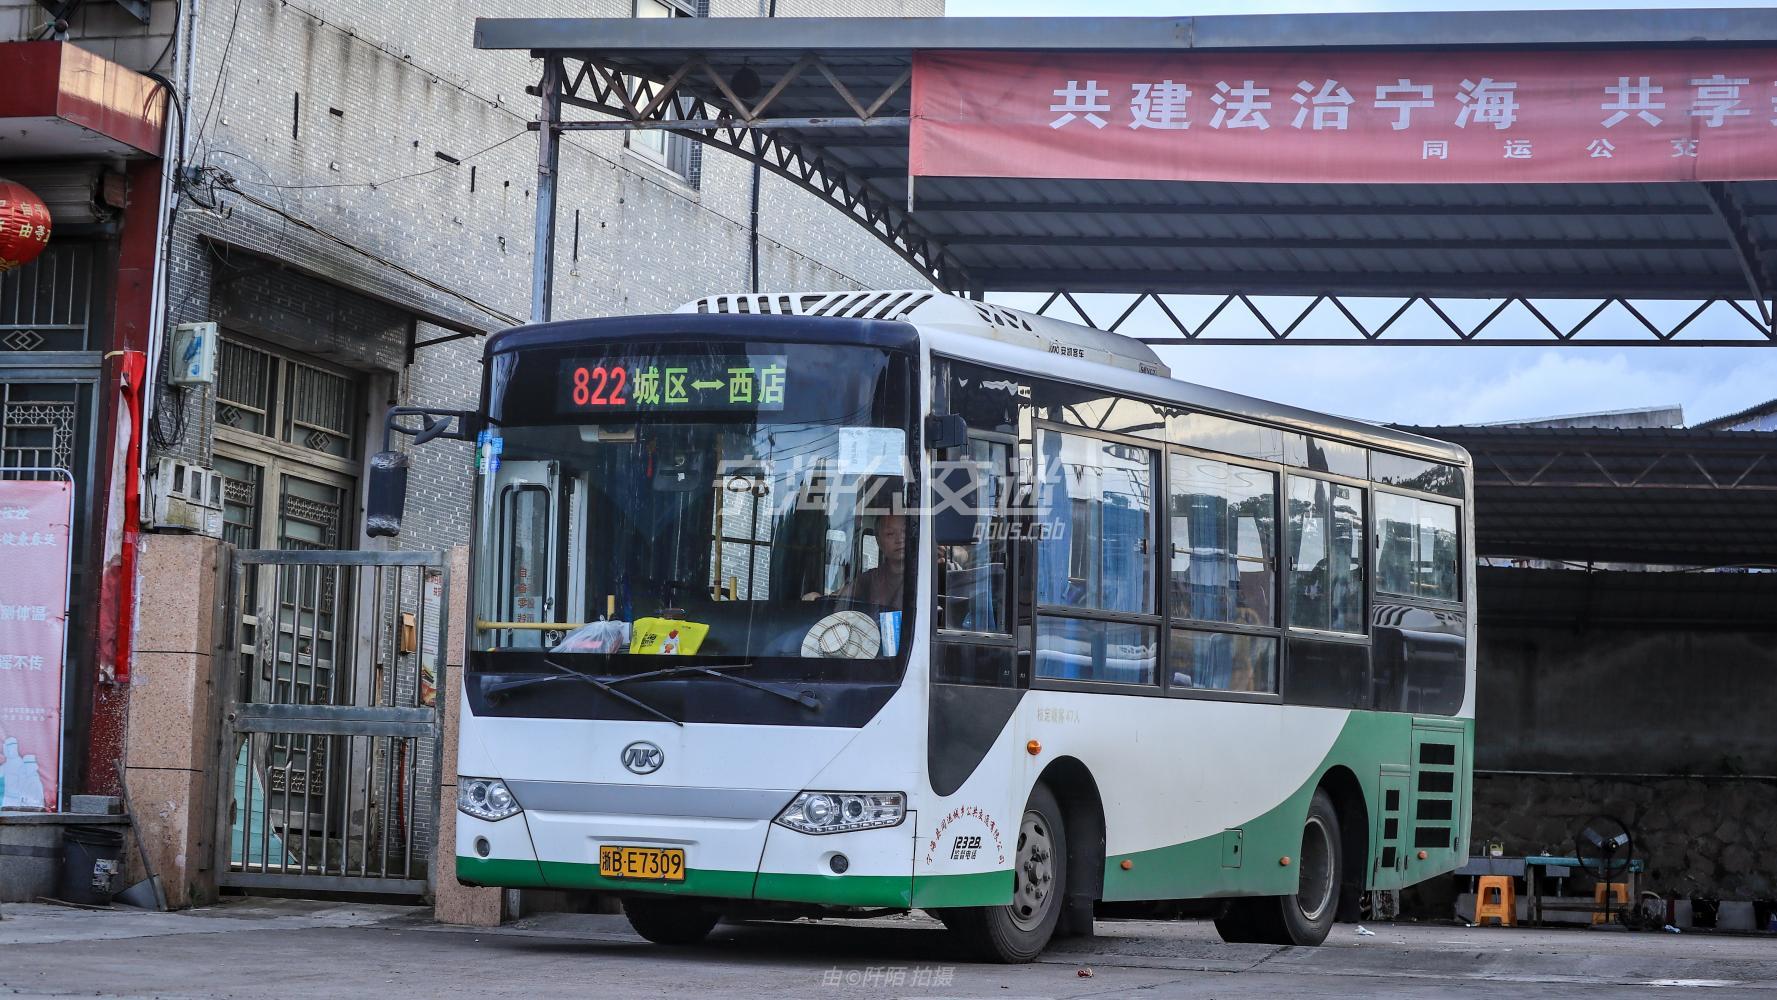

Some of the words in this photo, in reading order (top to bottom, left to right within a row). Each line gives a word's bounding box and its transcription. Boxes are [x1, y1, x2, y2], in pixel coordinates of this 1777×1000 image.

[1049, 77, 1520, 131] 共建法治宁海
[1601, 74, 1777, 129] 共享
[1422, 137, 1699, 160] 同运公交
[573, 367, 626, 405] 822
[633, 366, 689, 405] 城区
[727, 364, 787, 404] 西店
